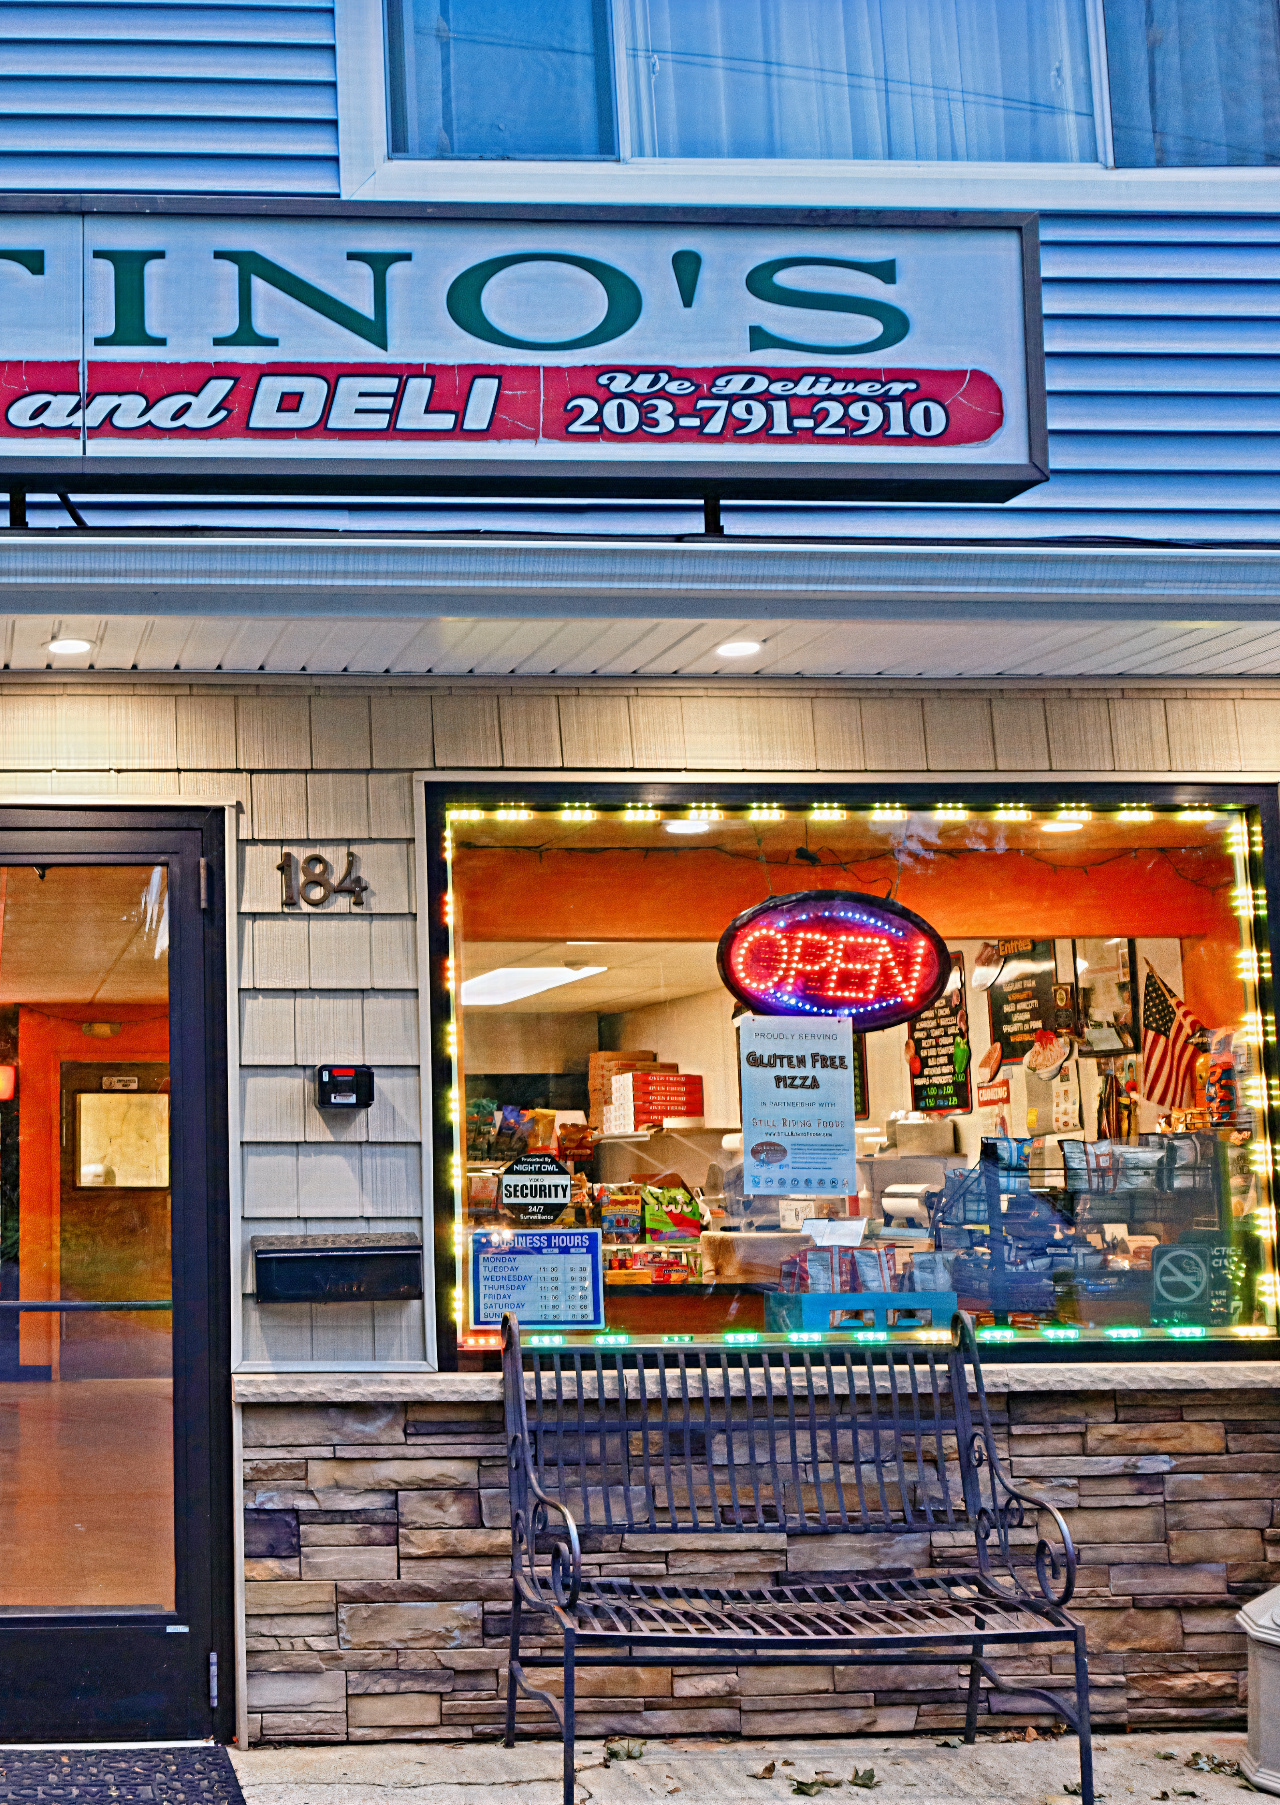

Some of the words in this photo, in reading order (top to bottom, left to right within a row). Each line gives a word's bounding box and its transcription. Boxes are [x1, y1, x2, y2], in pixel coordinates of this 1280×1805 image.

[598, 372, 695, 396] We
[708, 373, 917, 398] Deliver
[6, 373, 238, 431] and
[246, 374, 503, 434] DELI
[564, 397, 949, 438] 203-791-2910
[276, 851, 368, 906] 184
[738, 928, 926, 1003] OPEN
[754, 1032, 795, 1040] PROUDLY
[798, 1033, 838, 1041] SERVING
[746, 1051, 807, 1069] GLUTEN
[811, 1053, 848, 1070] FREE
[774, 1075, 820, 1089] PIZZA
[513, 1164, 540, 1172] NIGHT
[541, 1164, 559, 1172] OWL
[504, 1183, 569, 1199] SECURITY
[528, 1205, 544, 1213] 24/7
[551, 1235, 590, 1247] HOURS
[482, 1265, 519, 1273] TUESDAY
[483, 1302, 526, 1310] SATURDAY
